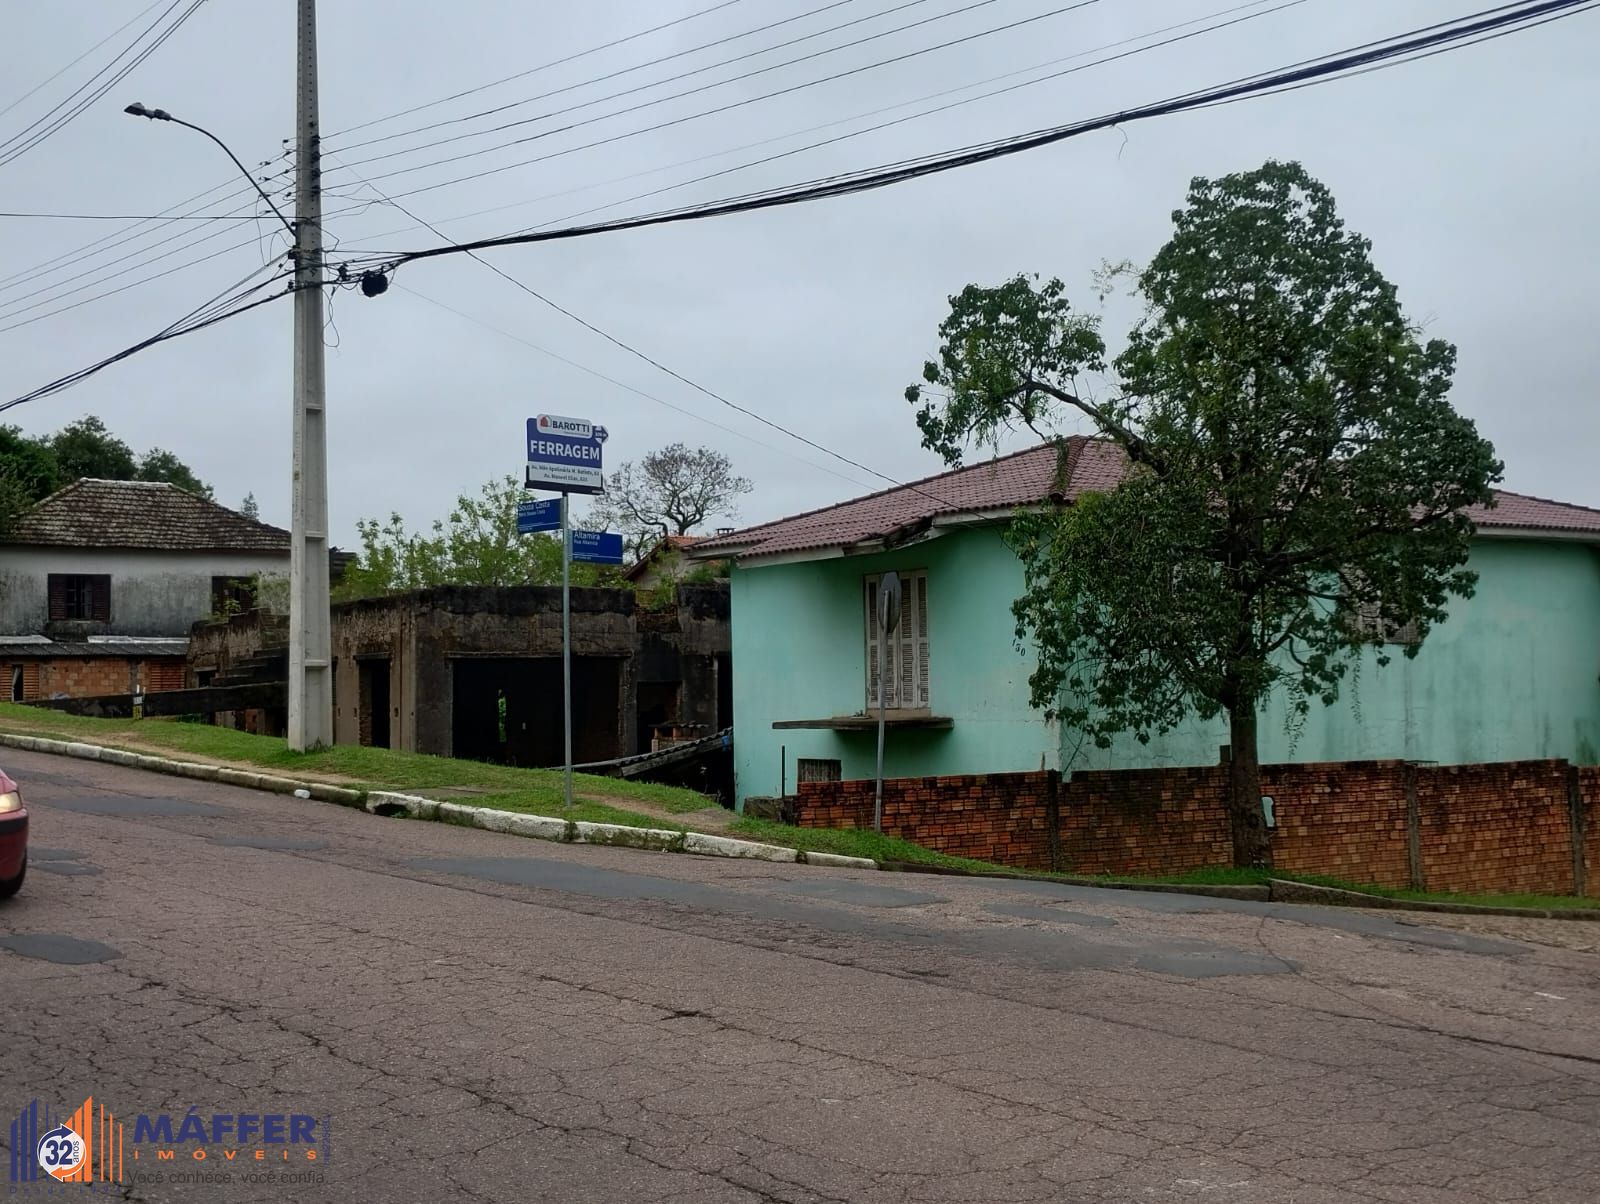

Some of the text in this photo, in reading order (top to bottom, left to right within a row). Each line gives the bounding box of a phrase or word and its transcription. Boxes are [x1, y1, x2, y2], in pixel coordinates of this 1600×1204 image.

[552, 420, 590, 433] BAROTTI
[530, 439, 600, 461] FERRAGEM
[574, 530, 600, 540] Altamira
